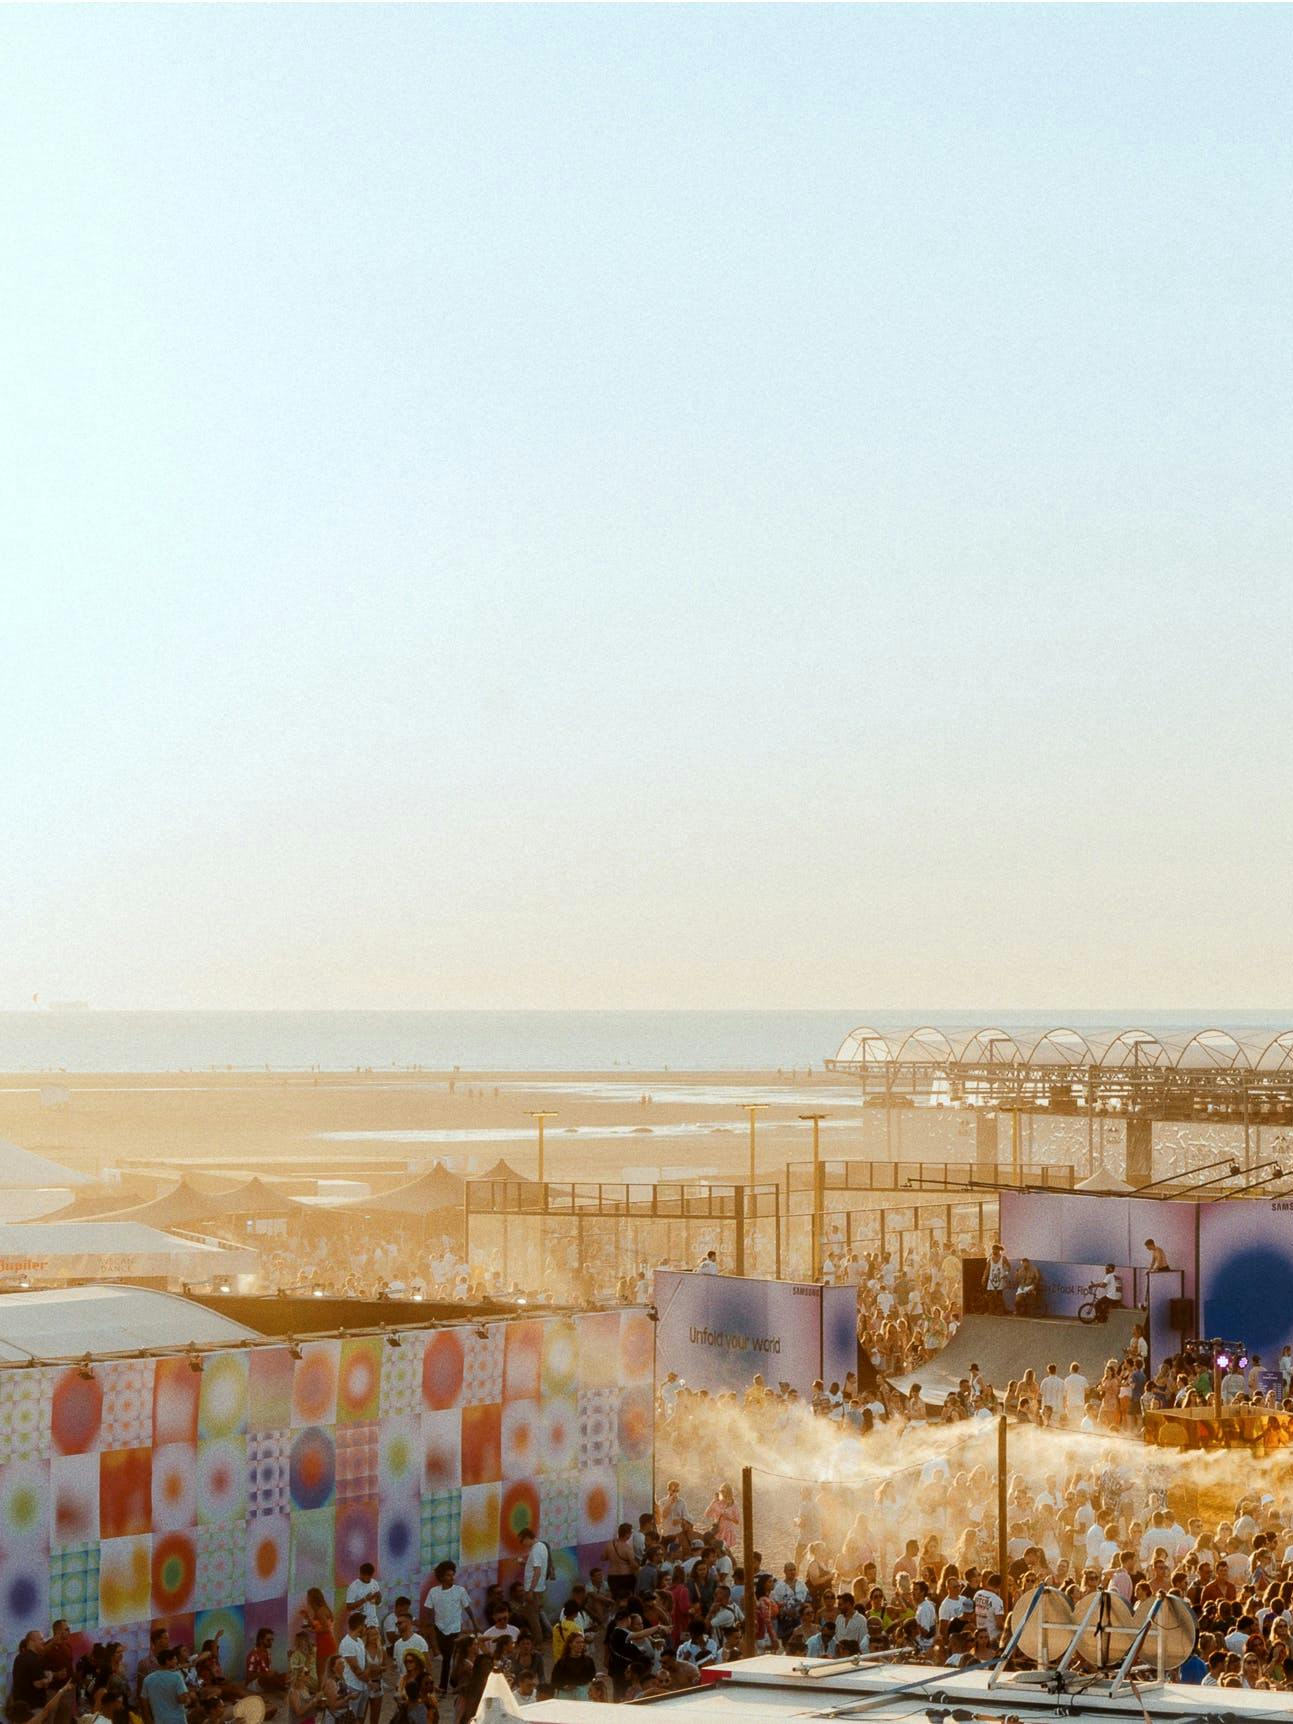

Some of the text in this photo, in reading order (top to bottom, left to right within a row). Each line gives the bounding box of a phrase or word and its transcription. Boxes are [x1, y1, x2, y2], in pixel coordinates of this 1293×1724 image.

[792, 1286, 820, 1298] SAMSUNG
[689, 1326, 781, 1354] Unfold your world
